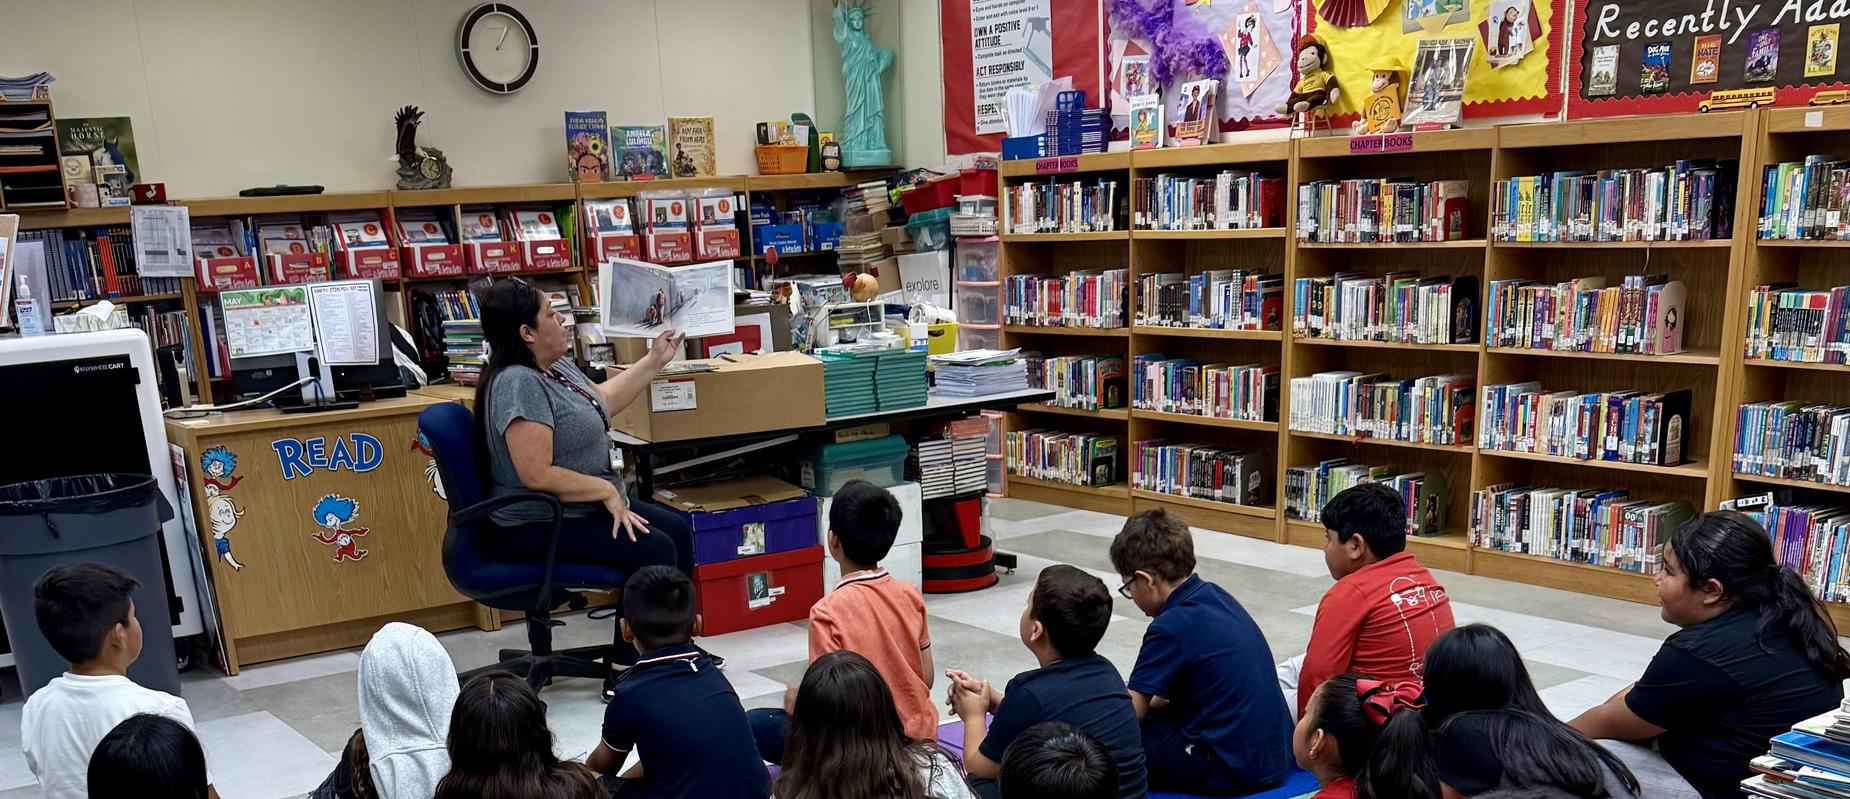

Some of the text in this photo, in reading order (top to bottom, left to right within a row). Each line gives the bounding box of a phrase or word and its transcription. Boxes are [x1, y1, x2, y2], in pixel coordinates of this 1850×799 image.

[974, 20, 1020, 37] OWN A POSITIVE
[1593, 0, 1760, 44] Recently
[975, 36, 1001, 48] ATTITUDE
[1752, 46, 1773, 58] FAMILY
[976, 60, 1025, 76] ACT RESPONSIBLY
[1350, 137, 1413, 150] CHAPTER BOOKS
[721, 201, 728, 211] U
[316, 256, 323, 264] B
[906, 277, 939, 292] explore
[272, 432, 384, 480] READ
